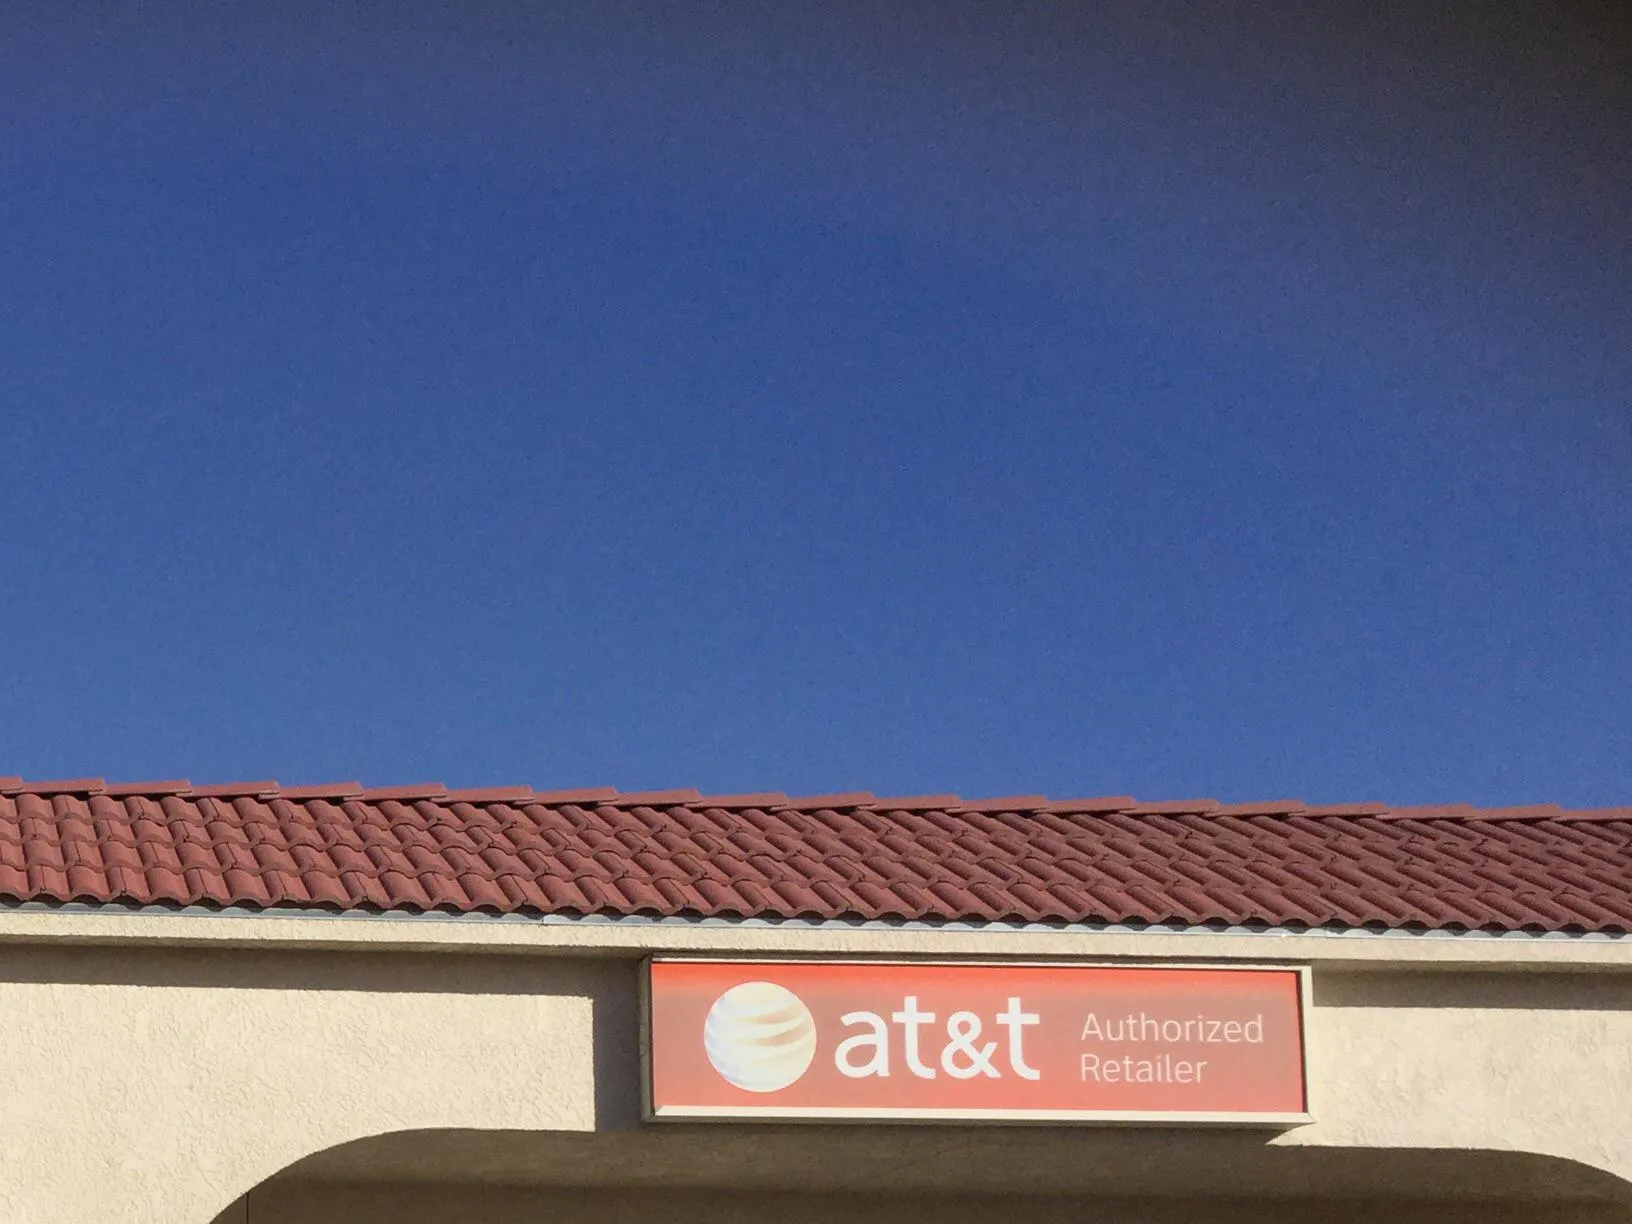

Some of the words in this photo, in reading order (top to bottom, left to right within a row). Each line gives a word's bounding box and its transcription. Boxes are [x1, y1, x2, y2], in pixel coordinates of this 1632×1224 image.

[834, 995, 1041, 1081] at&t
[1080, 1011, 1264, 1045] Authorized
[1080, 1052, 1207, 1084] Retailer
